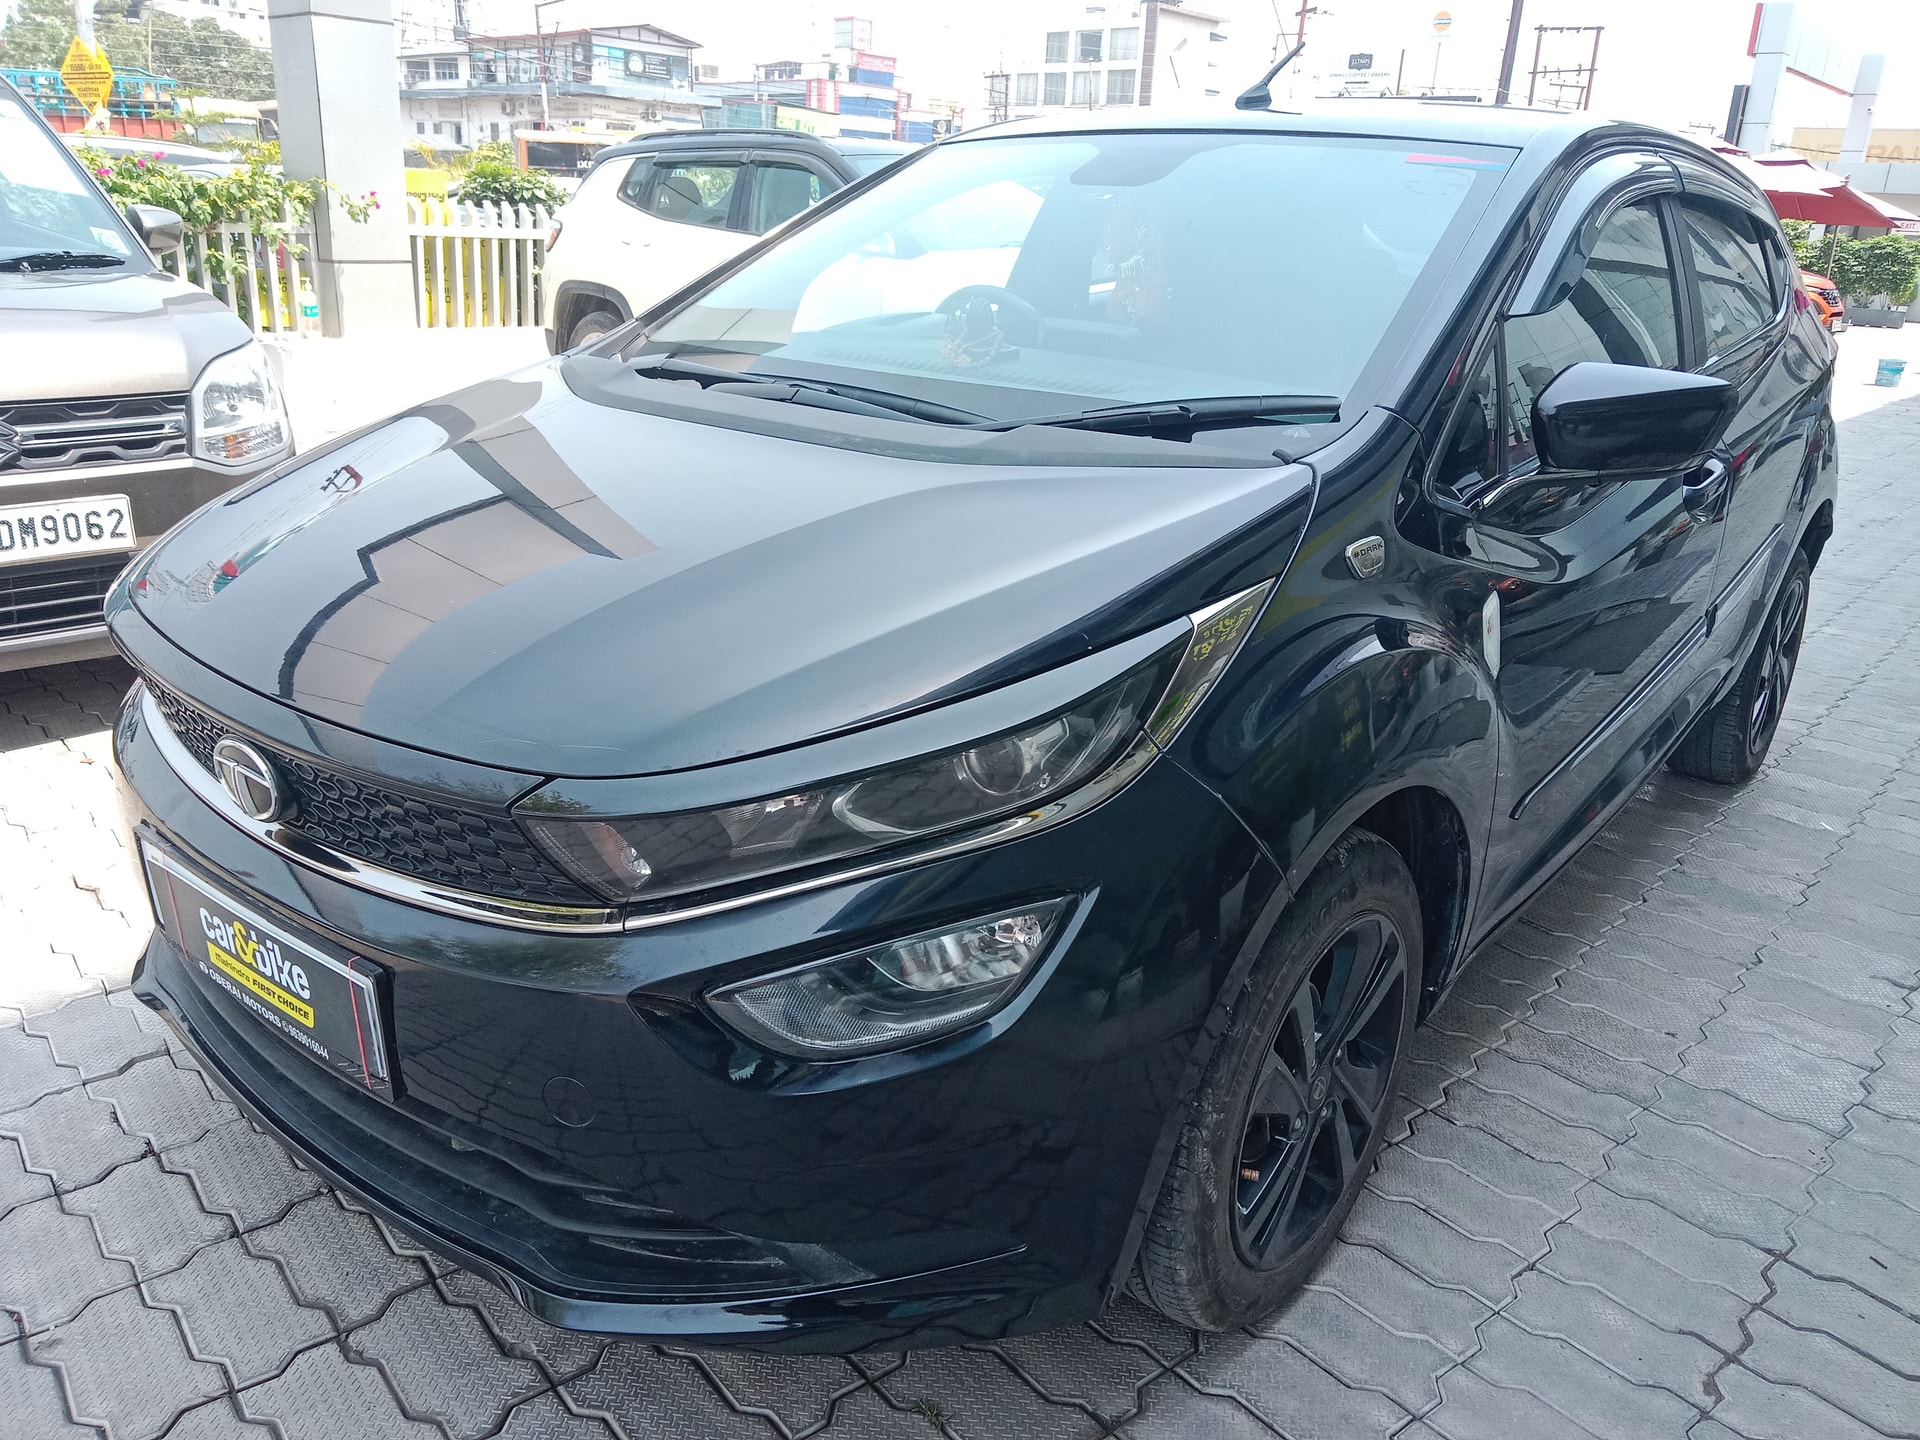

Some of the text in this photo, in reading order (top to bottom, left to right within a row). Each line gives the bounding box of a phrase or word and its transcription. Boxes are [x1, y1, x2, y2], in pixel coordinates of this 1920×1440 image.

[1900, 222, 1916, 230] EXIT
[1353, 541, 1384, 559] #DARK
[209, 968, 242, 1000] OBERAI
[241, 992, 282, 1028] MOTORS
[252, 979, 277, 999] FIRST
[277, 995, 311, 1021] CHOICE
